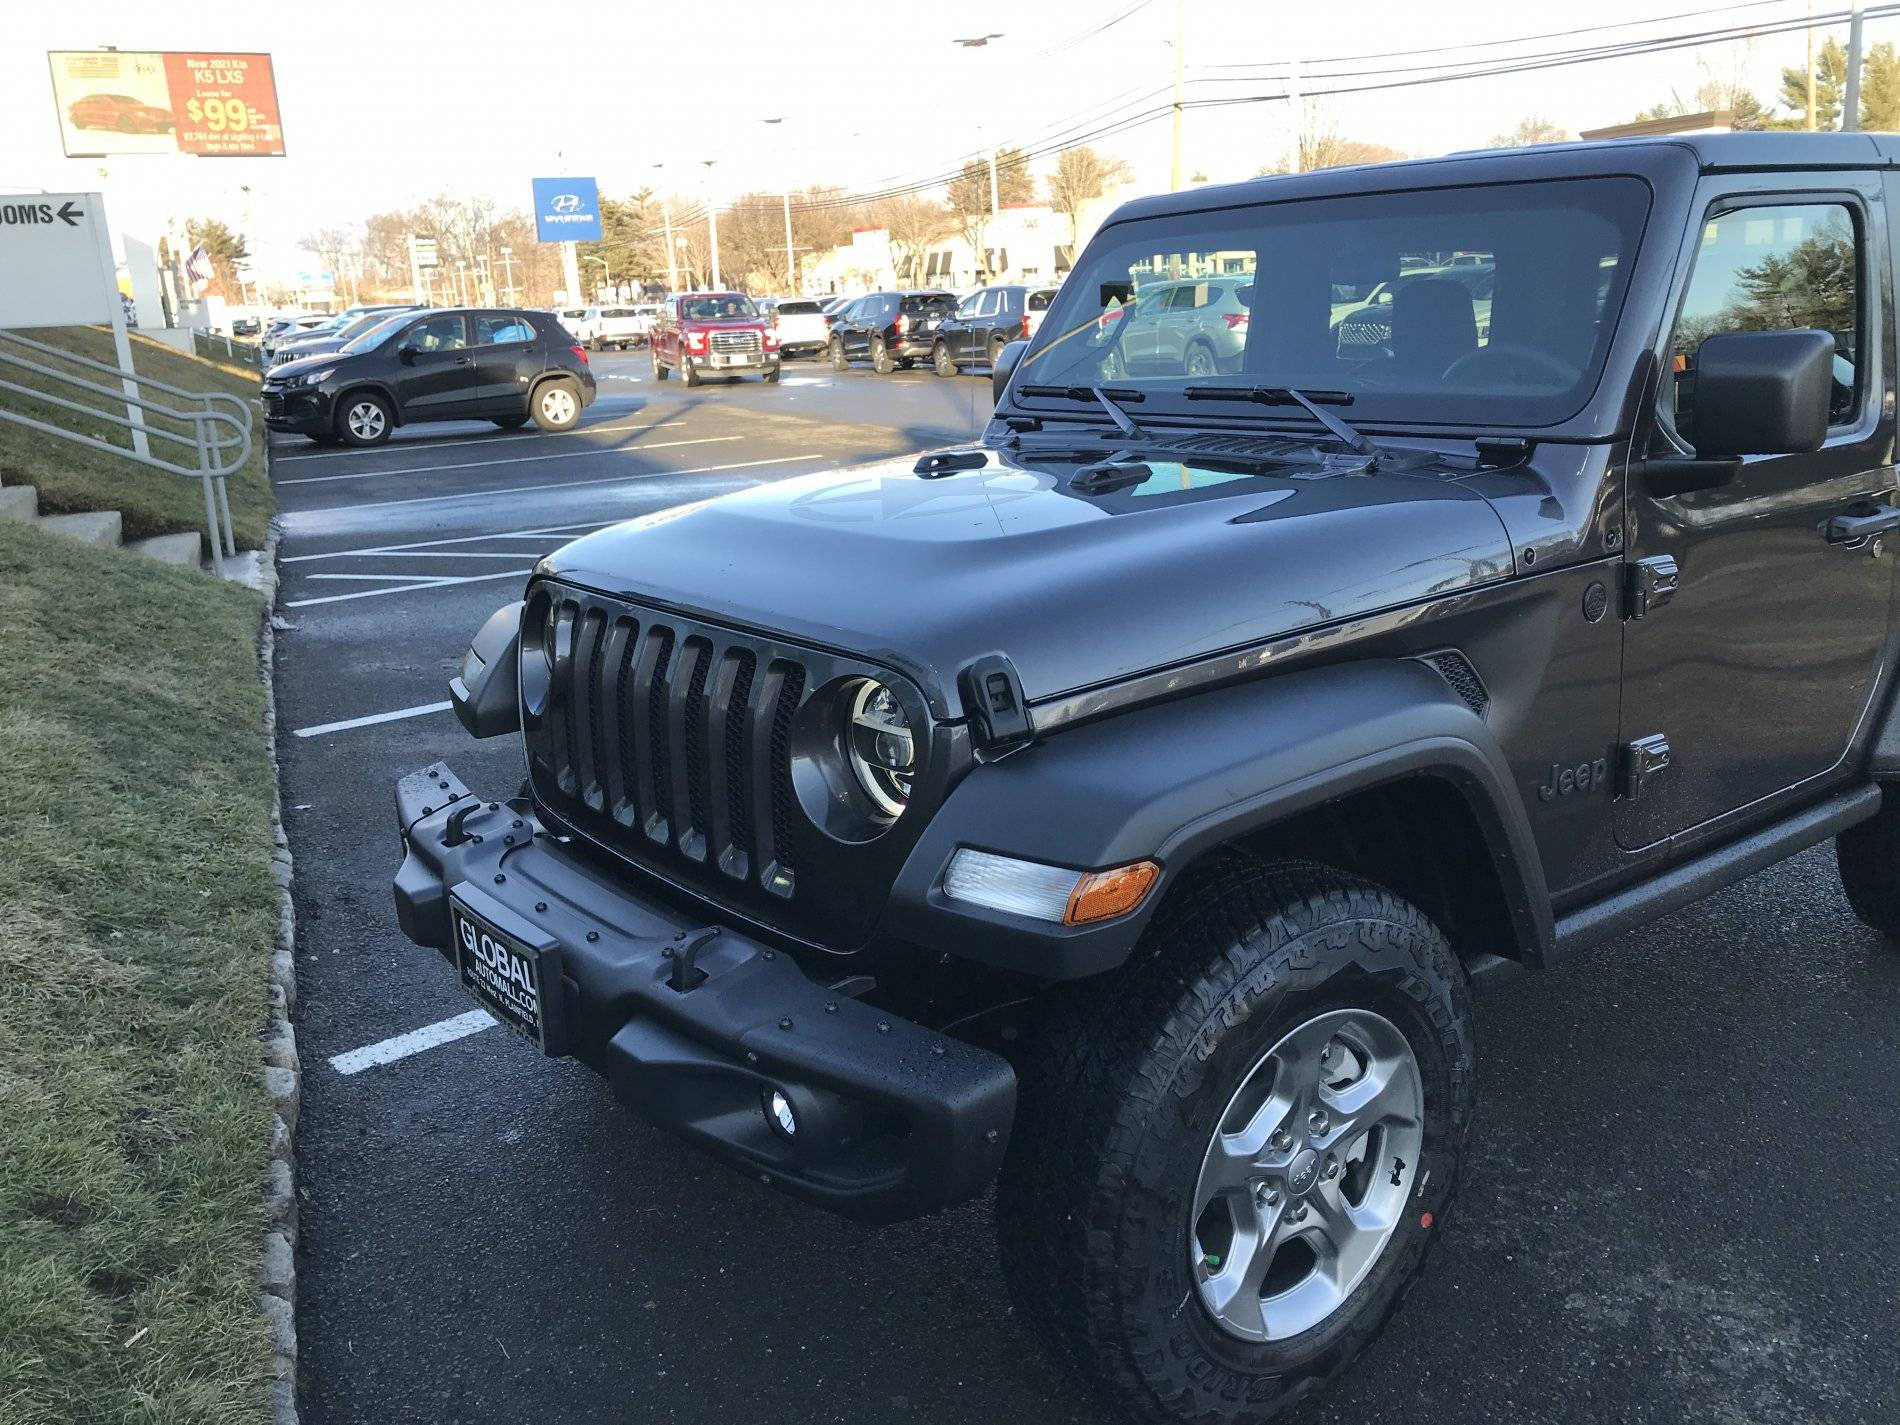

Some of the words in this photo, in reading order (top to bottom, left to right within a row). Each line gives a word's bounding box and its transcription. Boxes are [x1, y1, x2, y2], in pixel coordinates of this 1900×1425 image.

[194, 69, 214, 84] K5
[215, 70, 244, 84] LXS
[186, 97, 248, 132] $99
[0, 204, 54, 225] OMS
[1538, 758, 1609, 803] Jeep
[460, 917, 536, 996] GLOBAL
